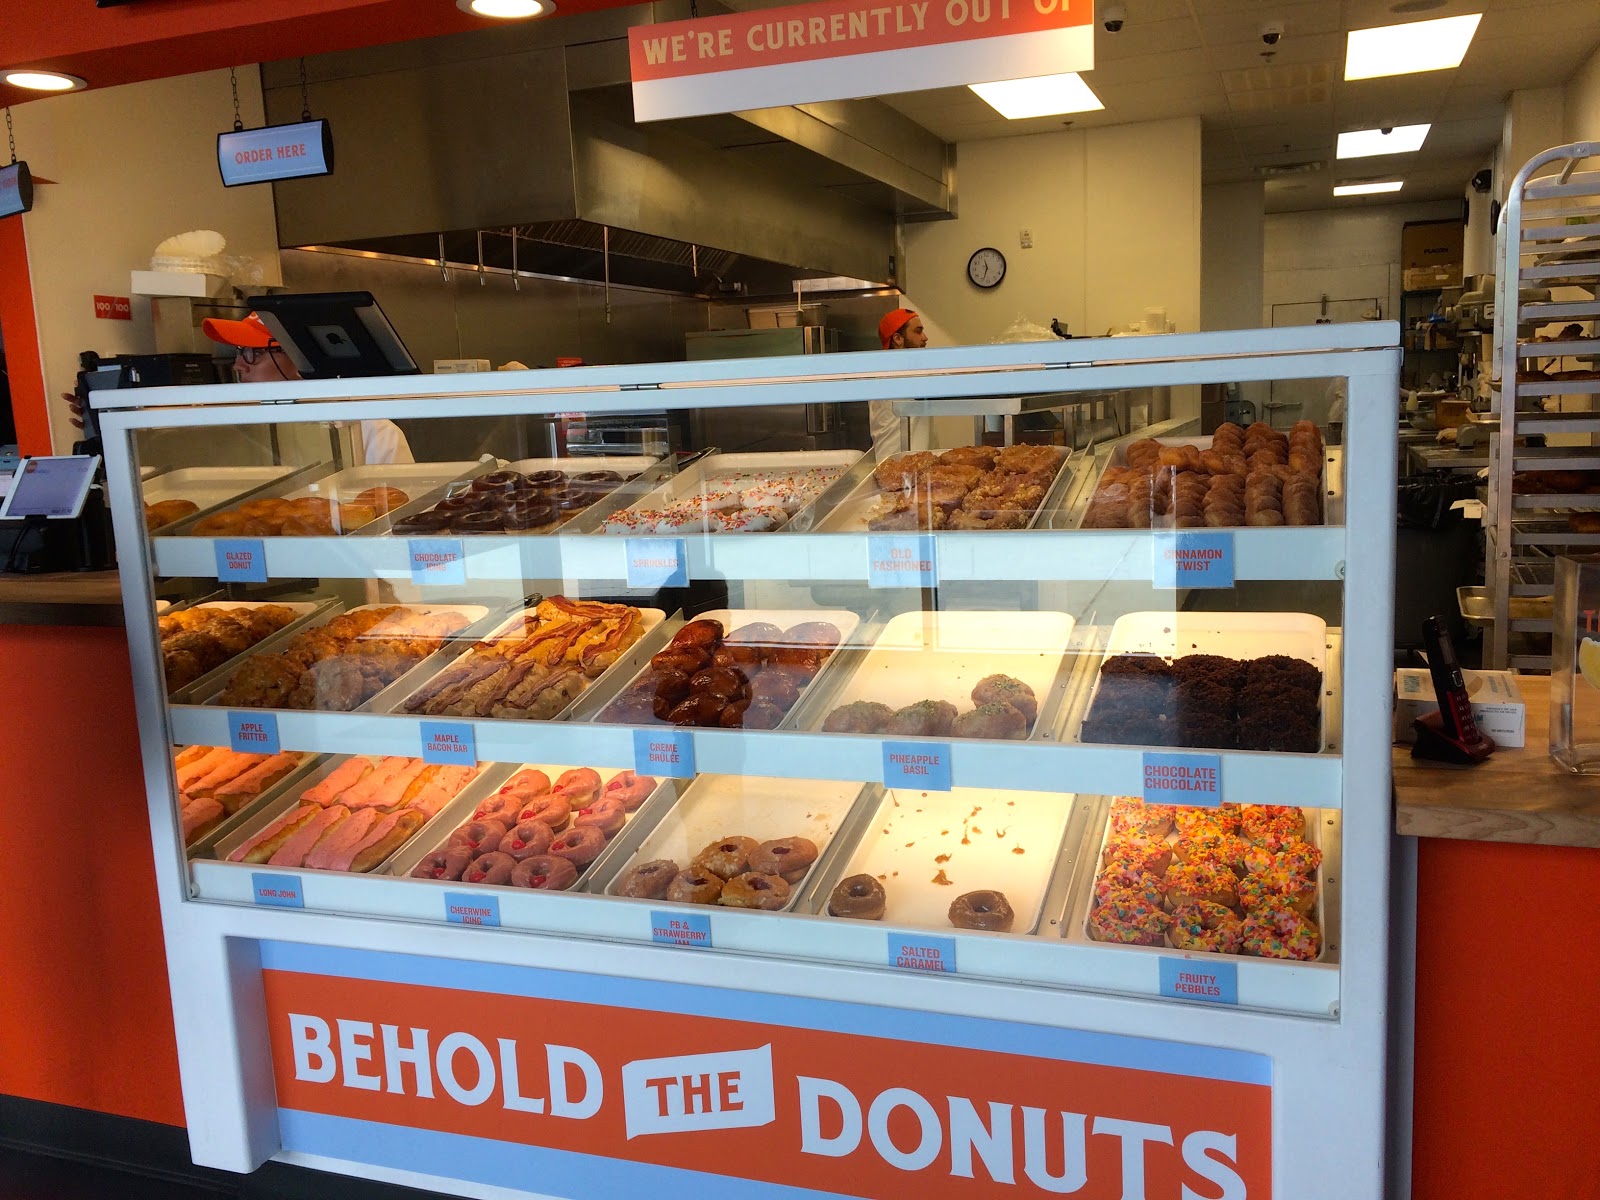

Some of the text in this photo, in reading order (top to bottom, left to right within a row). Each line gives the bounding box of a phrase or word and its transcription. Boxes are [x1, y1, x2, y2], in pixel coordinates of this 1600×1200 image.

[642, 28, 734, 65] WE'RE
[746, 2, 929, 52] CURRENTLY
[945, 0, 1010, 26] OUT
[235, 143, 306, 164] ORDER HERE
[226, 552, 252, 560] GLAZED
[414, 553, 457, 562] CHOCOLATE
[891, 548, 912, 559] OLD
[1164, 549, 1222, 559] CINNAMON
[229, 561, 251, 569] DONUT
[633, 558, 679, 568] SPRINKLES
[873, 560, 932, 572] FASHIONED
[1176, 561, 1210, 571] TWIST
[241, 723, 263, 732] APPLE
[238, 732, 268, 742] FRITTER
[434, 734, 459, 743] MAPLE
[427, 743, 468, 752] BACON BAR
[649, 742, 678, 753] CREME
[889, 753, 940, 765] PINEAPPLE
[903, 765, 929, 775] BASIL
[1144, 765, 1216, 779] CHOCOLATE
[1144, 778, 1217, 792] CHOCOLATE
[259, 889, 296, 898] LONG JOHN
[450, 905, 492, 917] CHEERWINE
[462, 916, 483, 925] ICING
[670, 920, 689, 930] PB &
[653, 927, 706, 940] STRAWBERRY
[901, 945, 940, 959] SALTED
[896, 956, 947, 971] CARAMEL
[1179, 972, 1216, 985] FRUITY
[1175, 982, 1220, 996] PEBBLES
[288, 1012, 1248, 1200] BEHOLD THE DONUTS
